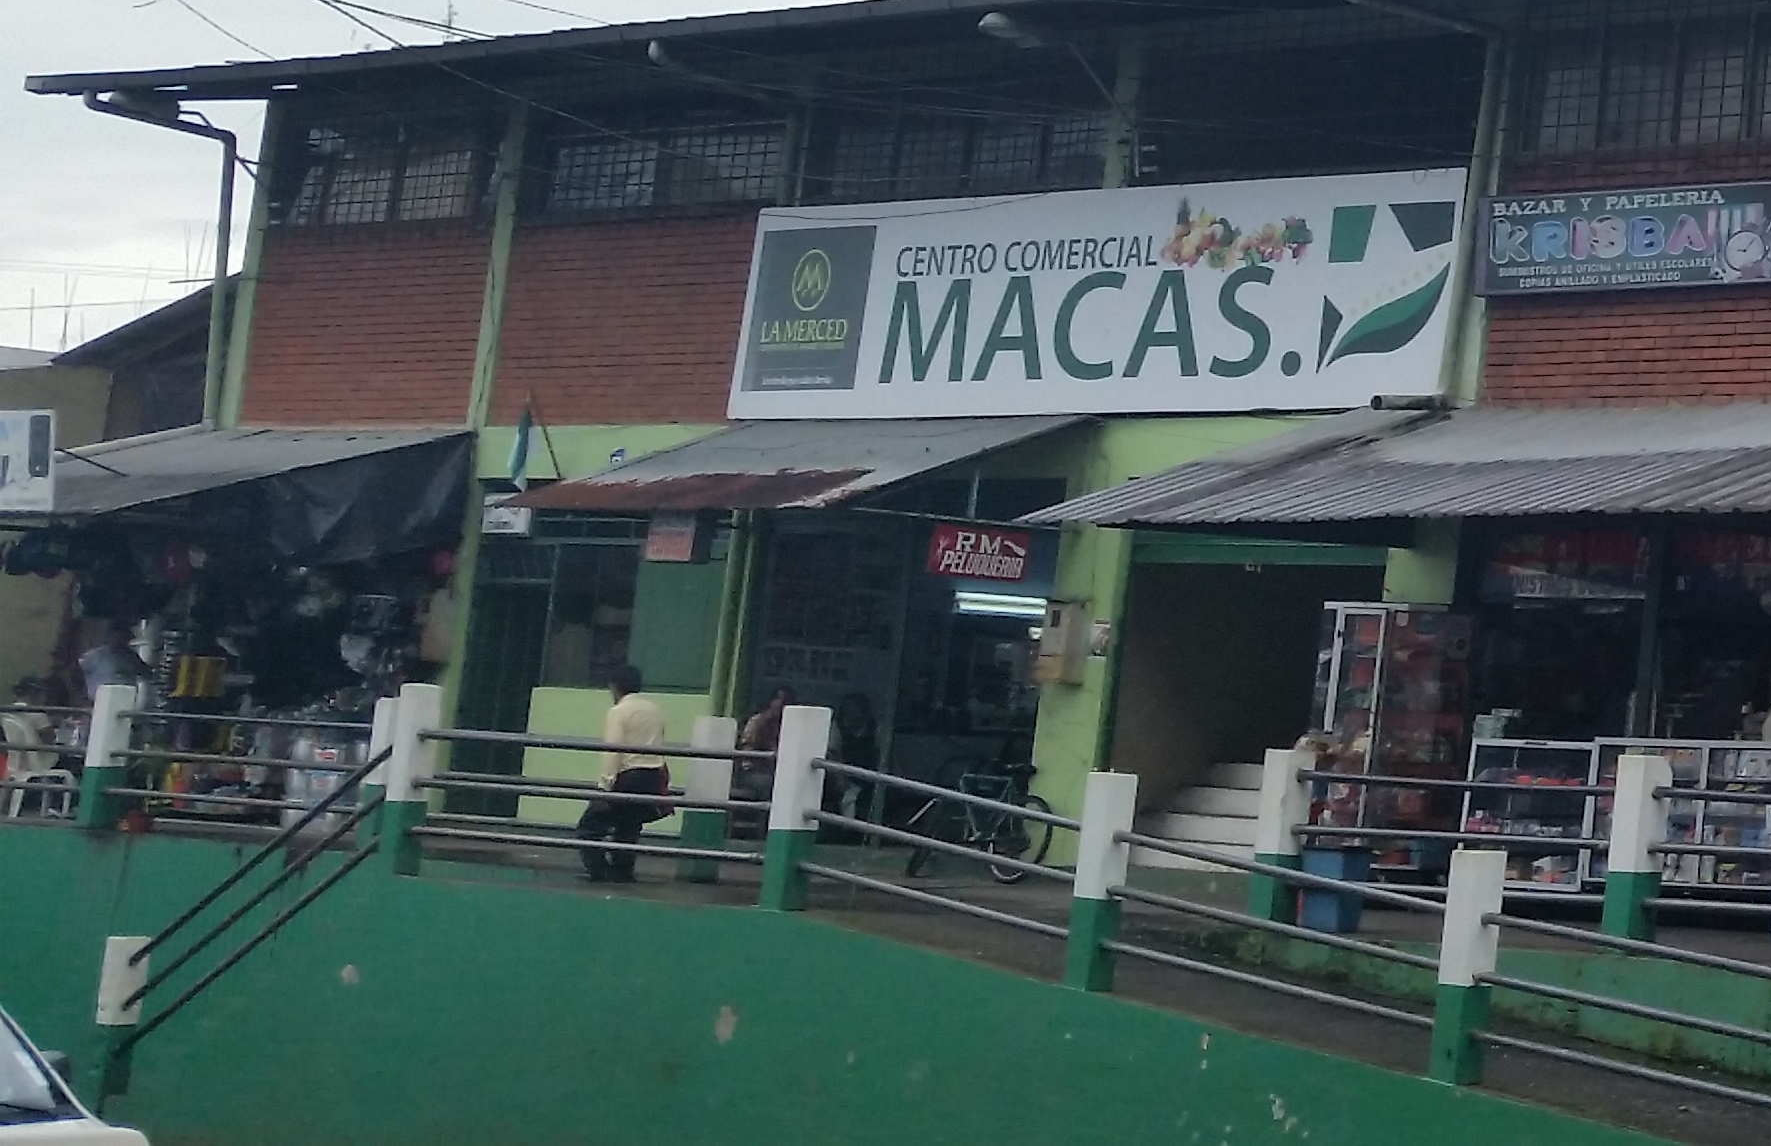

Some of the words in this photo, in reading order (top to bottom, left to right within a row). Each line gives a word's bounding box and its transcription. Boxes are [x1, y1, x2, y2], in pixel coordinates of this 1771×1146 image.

[1492, 199, 1567, 217] BAZAR
[1579, 197, 1592, 211] Y
[1605, 190, 1726, 211] PAPELERIA
[896, 238, 997, 277] CENTRO
[1003, 235, 1158, 272] COMERCIAL
[1489, 214, 1707, 265] KRISBA
[760, 321, 780, 343] LA
[783, 318, 848, 342] MERCED
[879, 265, 1301, 384] MACAS.
